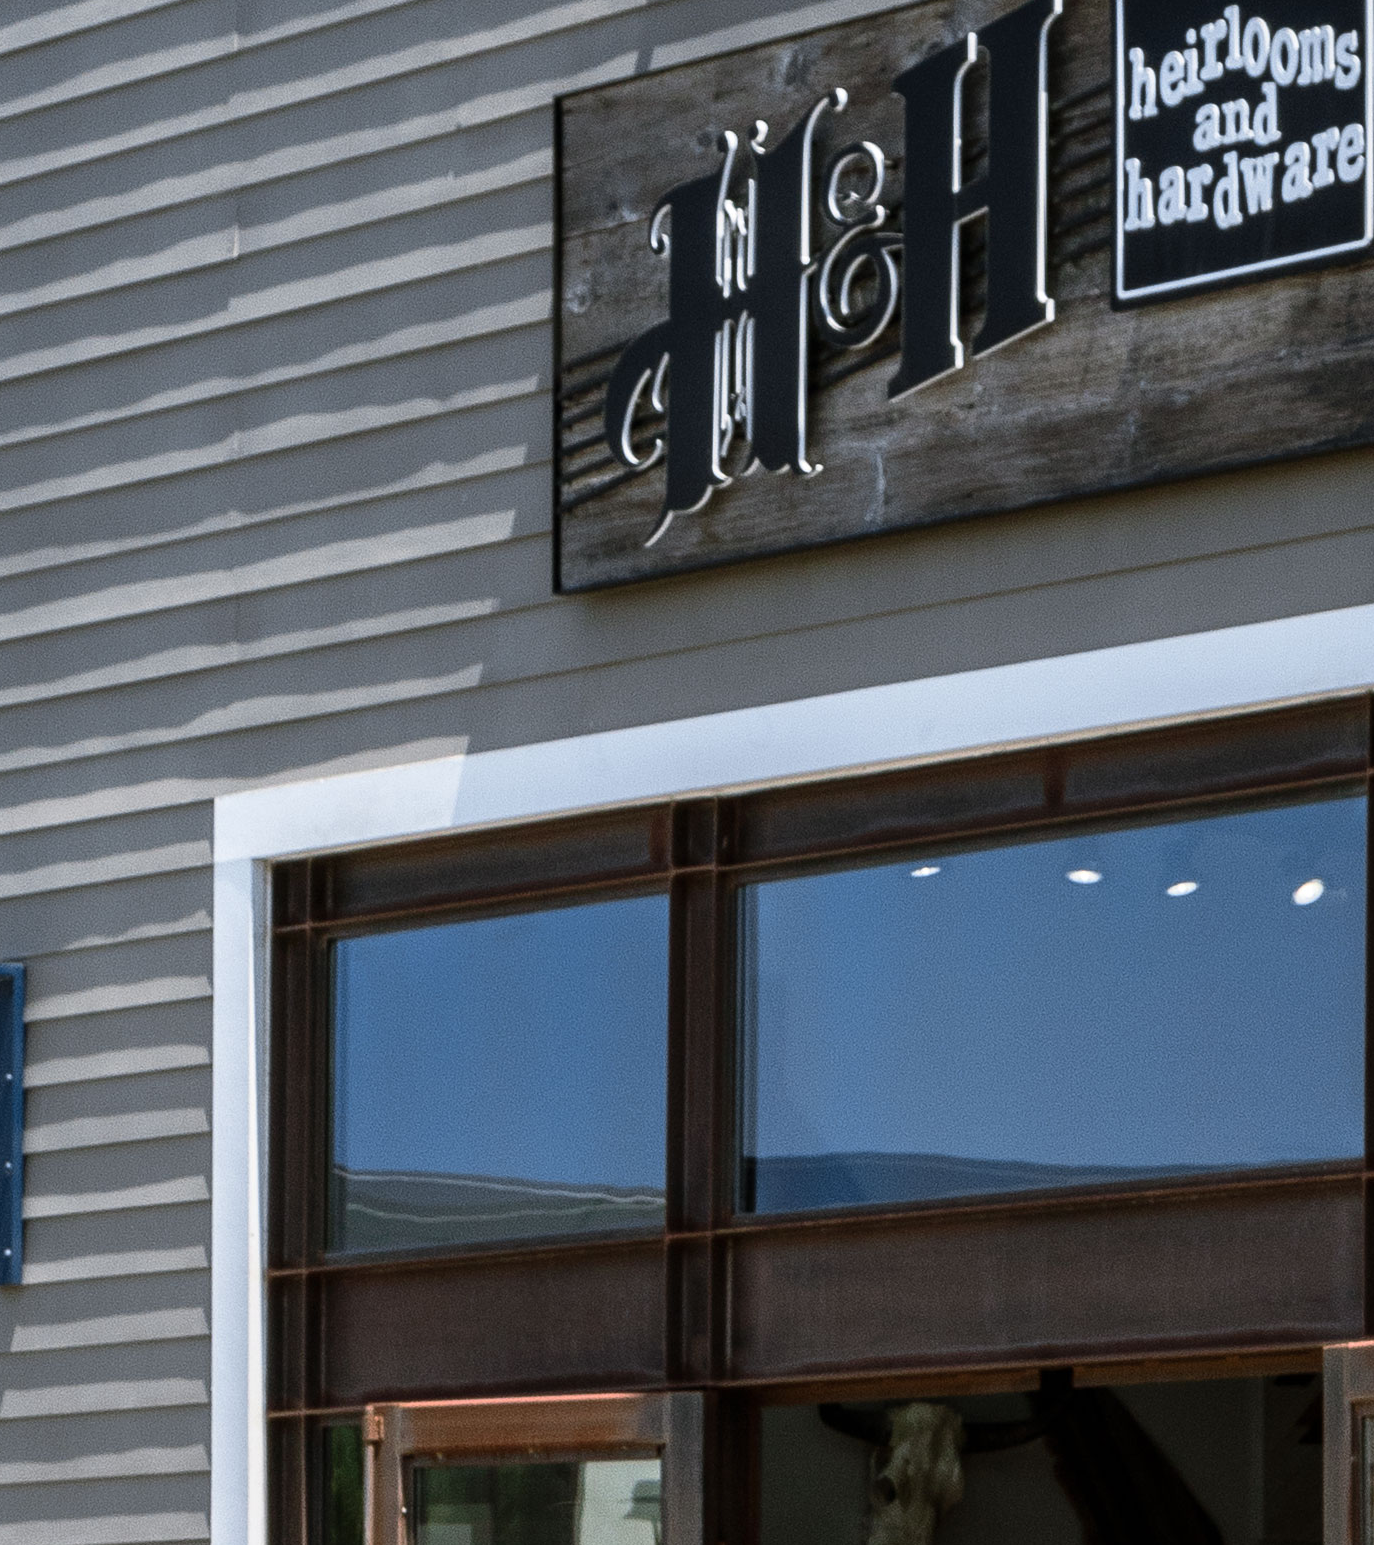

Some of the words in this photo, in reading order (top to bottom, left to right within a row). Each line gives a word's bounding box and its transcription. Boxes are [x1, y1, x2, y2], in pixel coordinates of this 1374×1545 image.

[1129, 4, 1362, 120] heirlooms
[1192, 82, 1283, 151] and
[1123, 121, 1367, 234] hardware
